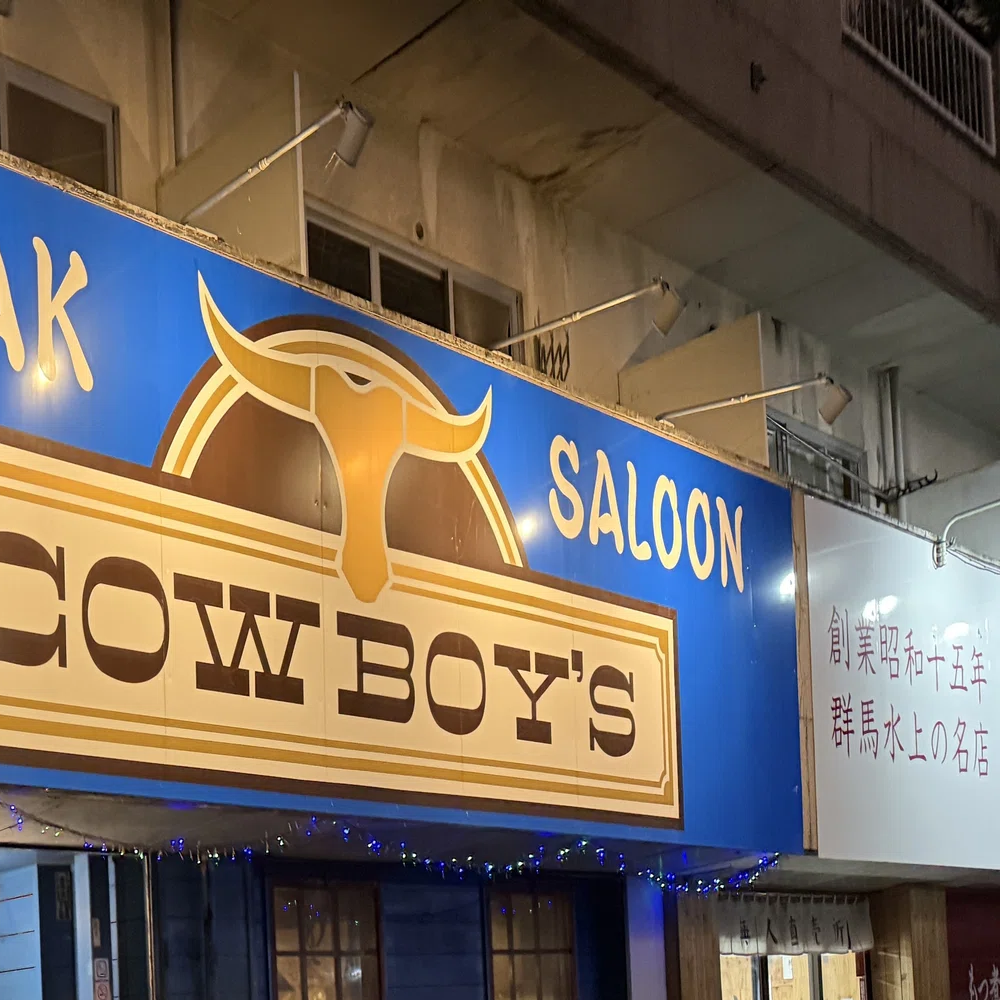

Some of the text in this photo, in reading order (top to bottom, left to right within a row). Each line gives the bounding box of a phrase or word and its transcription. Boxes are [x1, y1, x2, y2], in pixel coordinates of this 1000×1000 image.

[549, 434, 744, 593] SALOON
[828, 605, 987, 704] 創業昭和十五年
[831, 693, 989, 776] 群馬水上の名店
